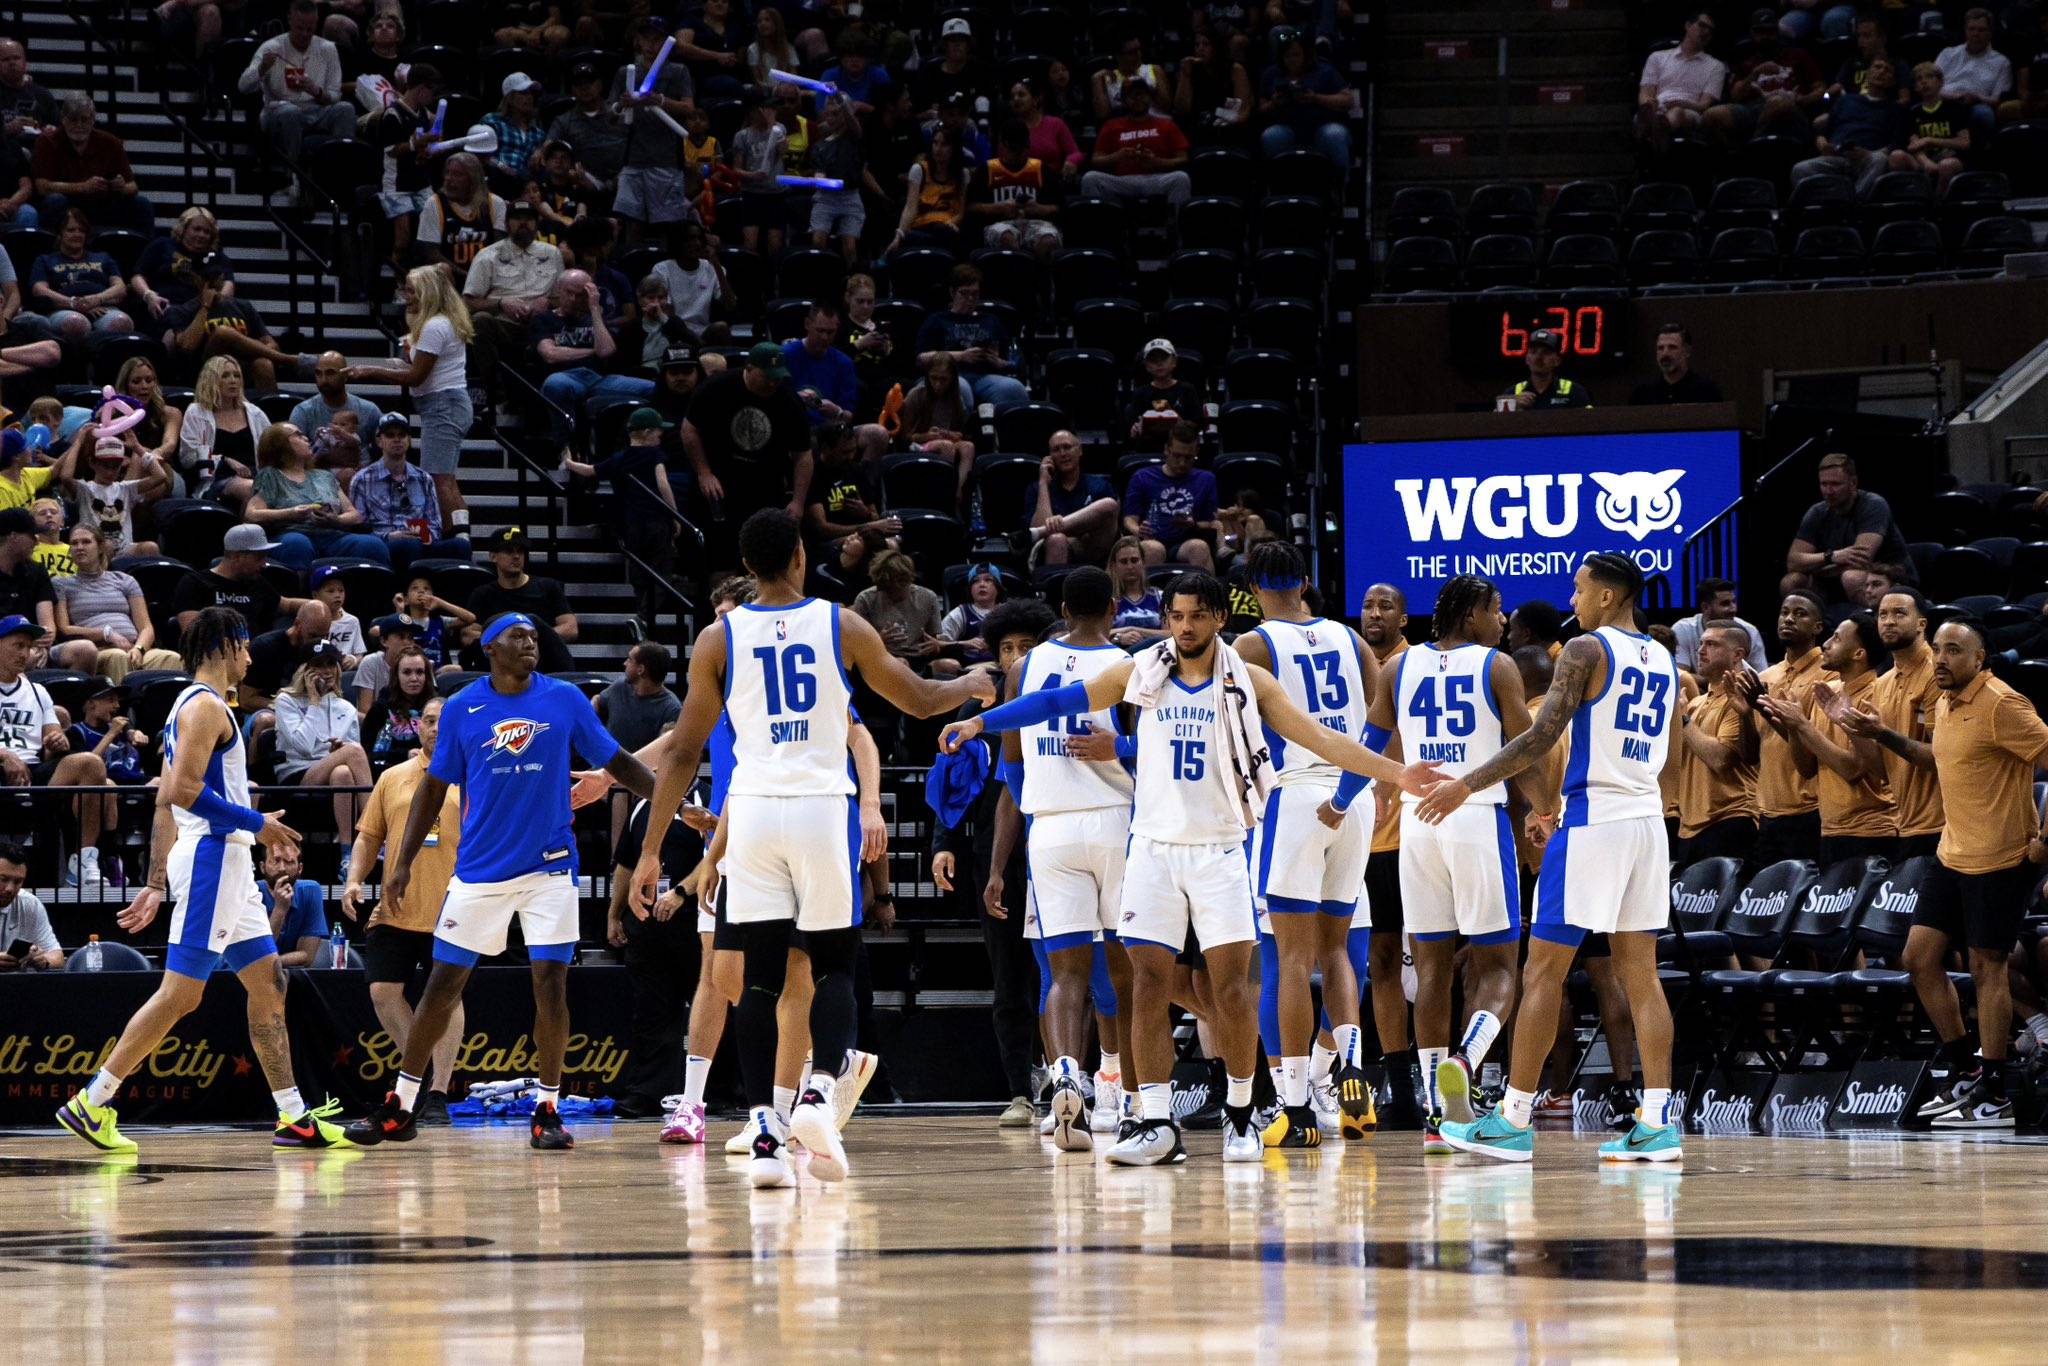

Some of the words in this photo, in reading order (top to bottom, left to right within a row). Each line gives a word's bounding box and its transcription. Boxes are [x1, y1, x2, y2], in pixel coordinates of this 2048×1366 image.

[1394, 473, 1583, 542] WGU
[1407, 555, 1448, 578] THE
[1455, 551, 1578, 577] UNIVERSITY
[753, 643, 817, 716] 16
[1293, 650, 1349, 713] 13
[1156, 706, 1216, 724] OKLAHOM
[1408, 674, 1476, 737] 45
[1614, 666, 1670, 737] 23
[0, 708, 35, 727] AZZ
[770, 720, 809, 744] SMITH
[1175, 723, 1202, 738] CITY
[1317, 715, 1347, 734] ENG
[495, 725, 530, 750] OKC
[1420, 742, 1467, 763] RAMSEY
[1621, 737, 1651, 763] MANN
[1170, 739, 1206, 781] 15
[1671, 881, 1720, 914] Smith's
[1732, 887, 1788, 917] Smith's
[1802, 884, 1857, 914] Smith's
[1872, 880, 1919, 914] Smit
[148, 1036, 225, 1088] City
[453, 1032, 541, 1073] Lake
[562, 1033, 630, 1083] City
[8, 1082, 76, 1098] MMER
[1693, 1088, 1753, 1120] Smith's
[1838, 1080, 1906, 1114] Smith's
[1764, 1093, 1829, 1122] Smith's
